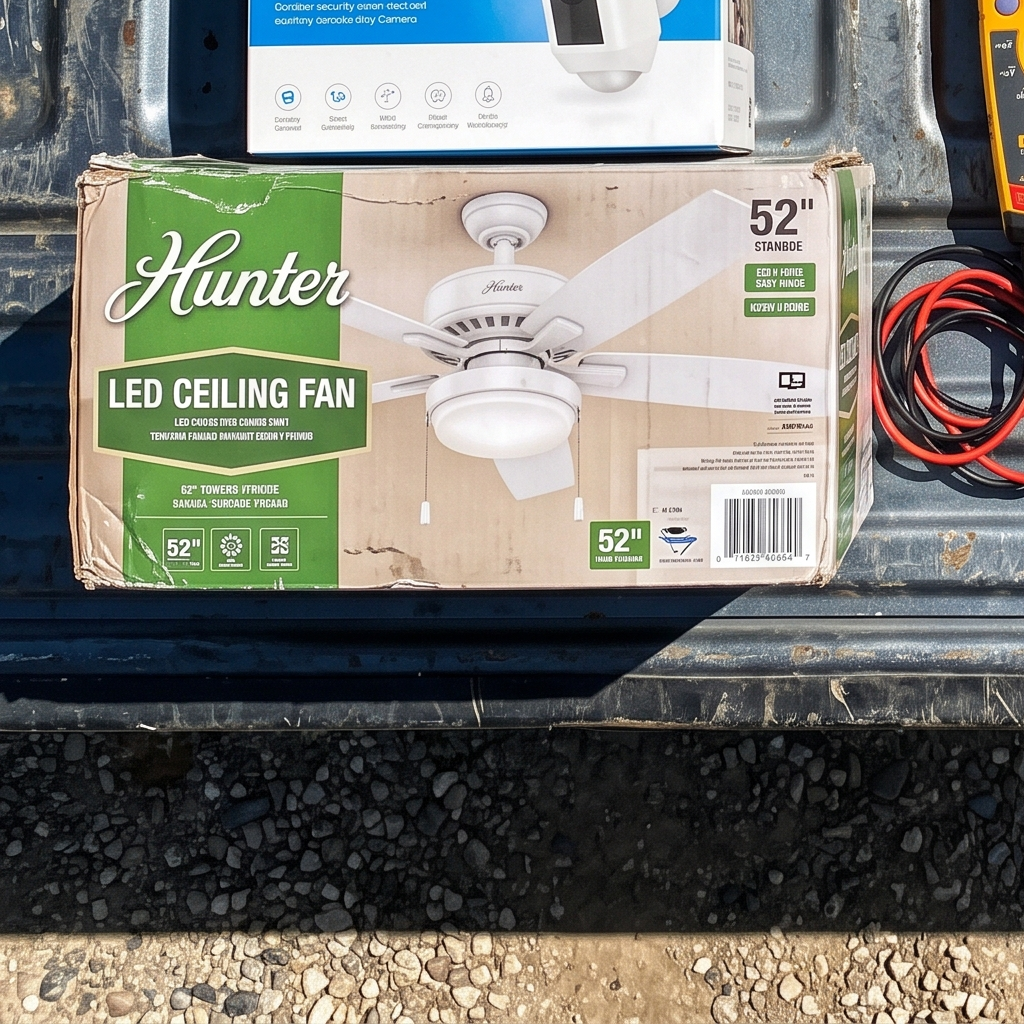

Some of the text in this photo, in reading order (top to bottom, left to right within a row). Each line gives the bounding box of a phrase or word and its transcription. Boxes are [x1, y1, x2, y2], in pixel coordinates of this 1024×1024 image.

[316, 1, 354, 13] security
[750, 198, 814, 236] 52"
[104, 229, 351, 323] Hunter
[481, 279, 523, 295] Hunter
[108, 377, 355, 409] LED CEILING FAN
[200, 485, 239, 495] TOWERS
[167, 539, 201, 557] 52"
[598, 528, 642, 553] 52"
